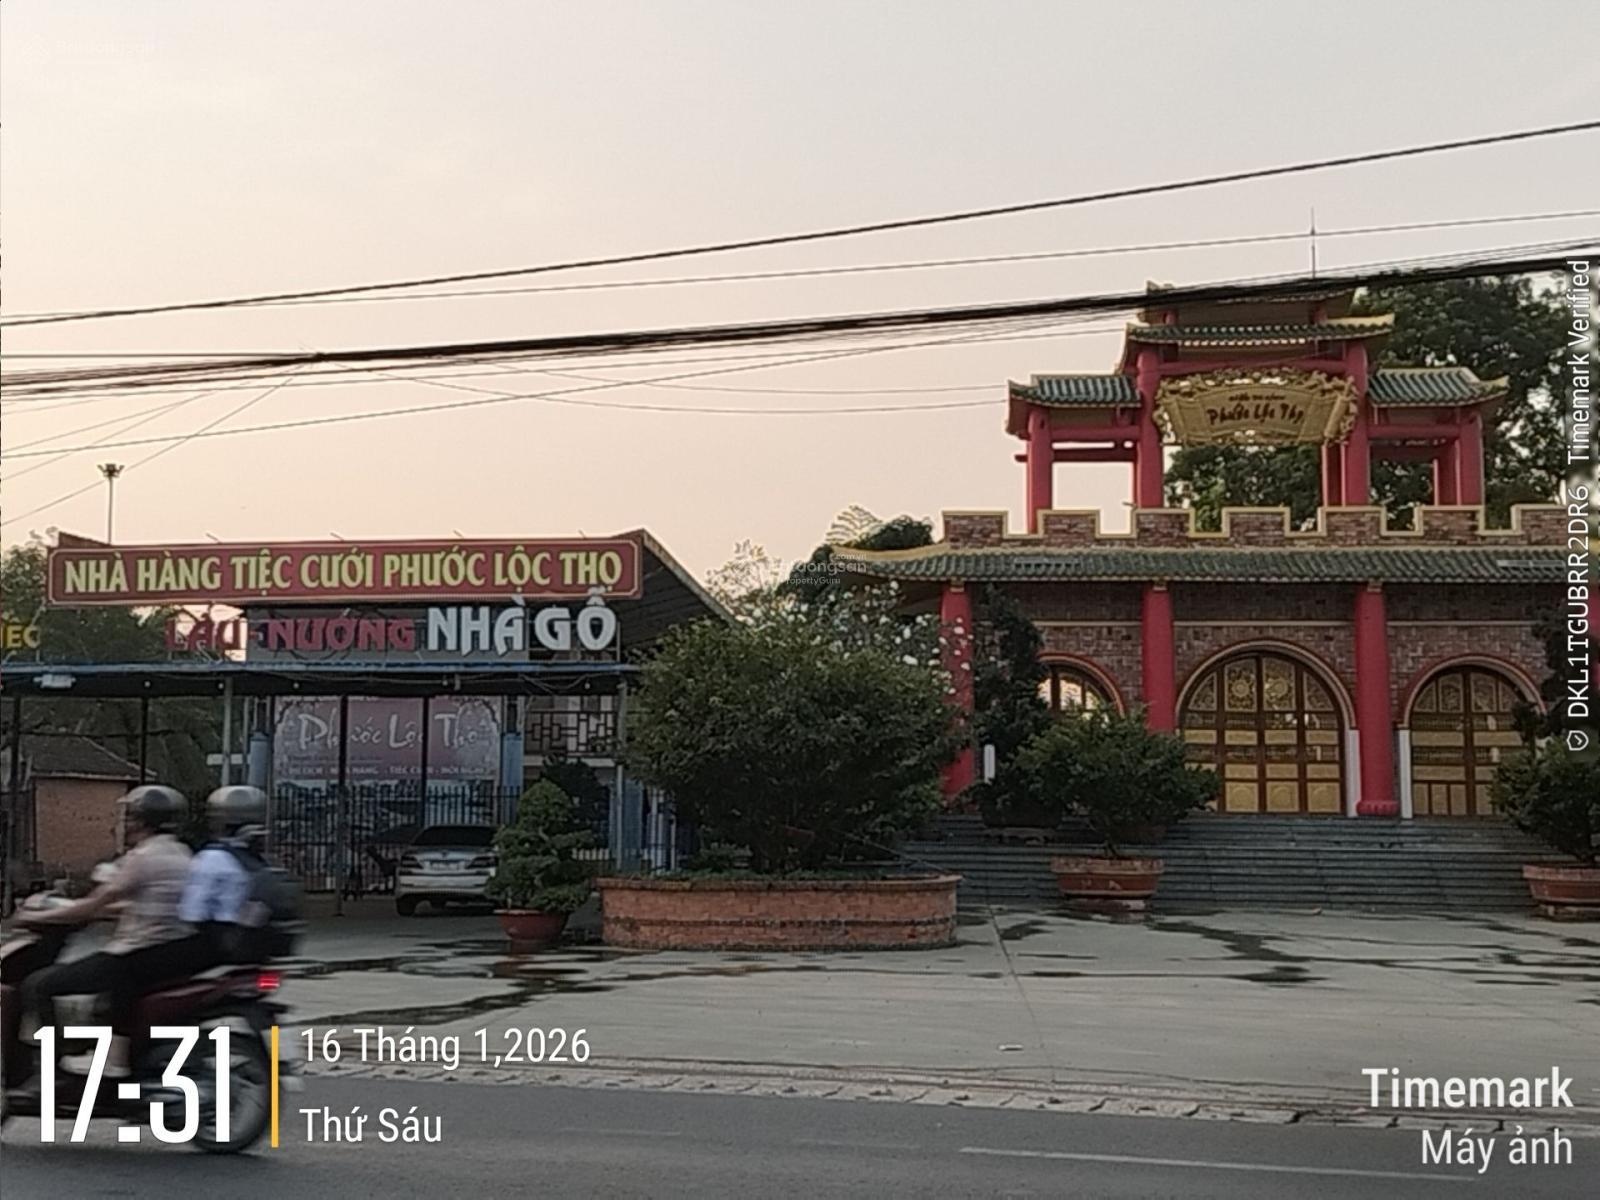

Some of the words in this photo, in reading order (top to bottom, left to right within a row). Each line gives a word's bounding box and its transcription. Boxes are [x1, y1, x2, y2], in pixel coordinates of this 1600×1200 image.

[64, 551, 130, 594] NHÀ
[136, 550, 222, 593] HÀNG
[230, 548, 292, 596] TIỆC
[301, 547, 375, 589] CƯỚI
[384, 545, 486, 588] PHƯỚC
[494, 544, 552, 593] LỘC
[559, 551, 623, 592] THỌ
[427, 593, 526, 657] NHÀ
